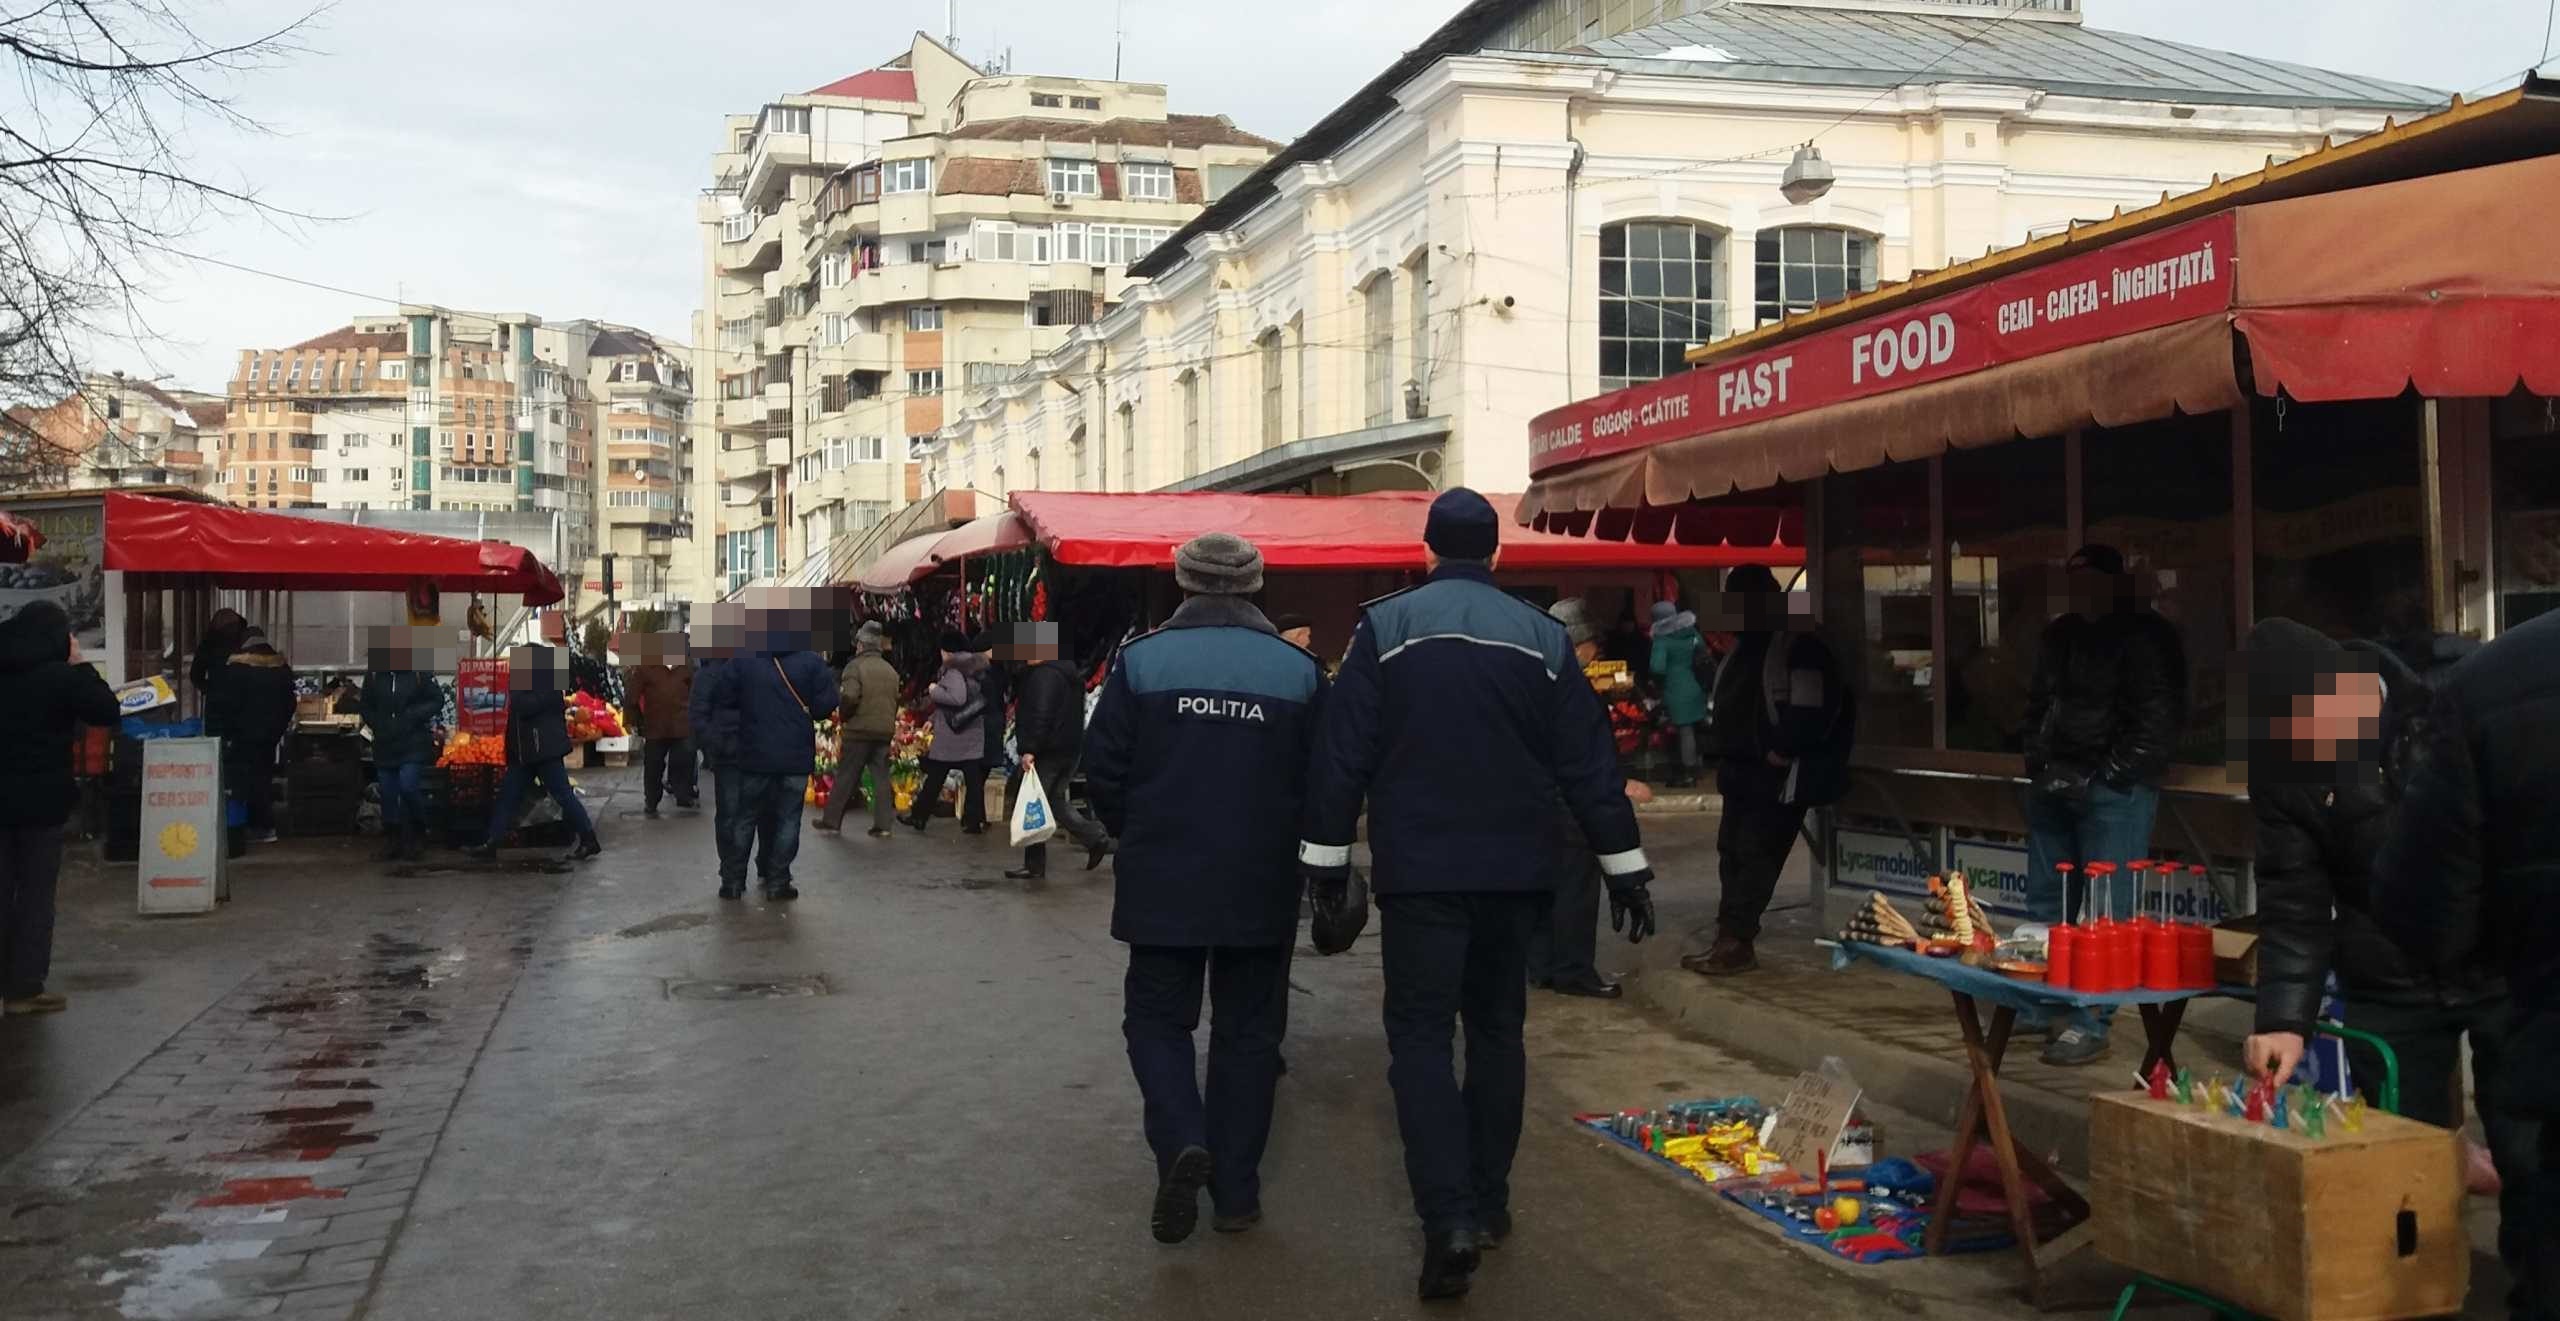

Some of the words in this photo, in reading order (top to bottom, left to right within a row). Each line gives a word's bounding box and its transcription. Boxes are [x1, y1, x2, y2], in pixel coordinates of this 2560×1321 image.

[1998, 297, 2034, 335] CEAI
[2046, 279, 2099, 322] CAFEA
[1718, 356, 1793, 417] FAST
[1852, 312, 1956, 384] FOOD
[1549, 423, 1582, 450] CALDE
[1177, 697, 1265, 722] POLITIA
[1840, 844, 1928, 878] Lycamobile
[1957, 858, 2028, 892] Lycamo
